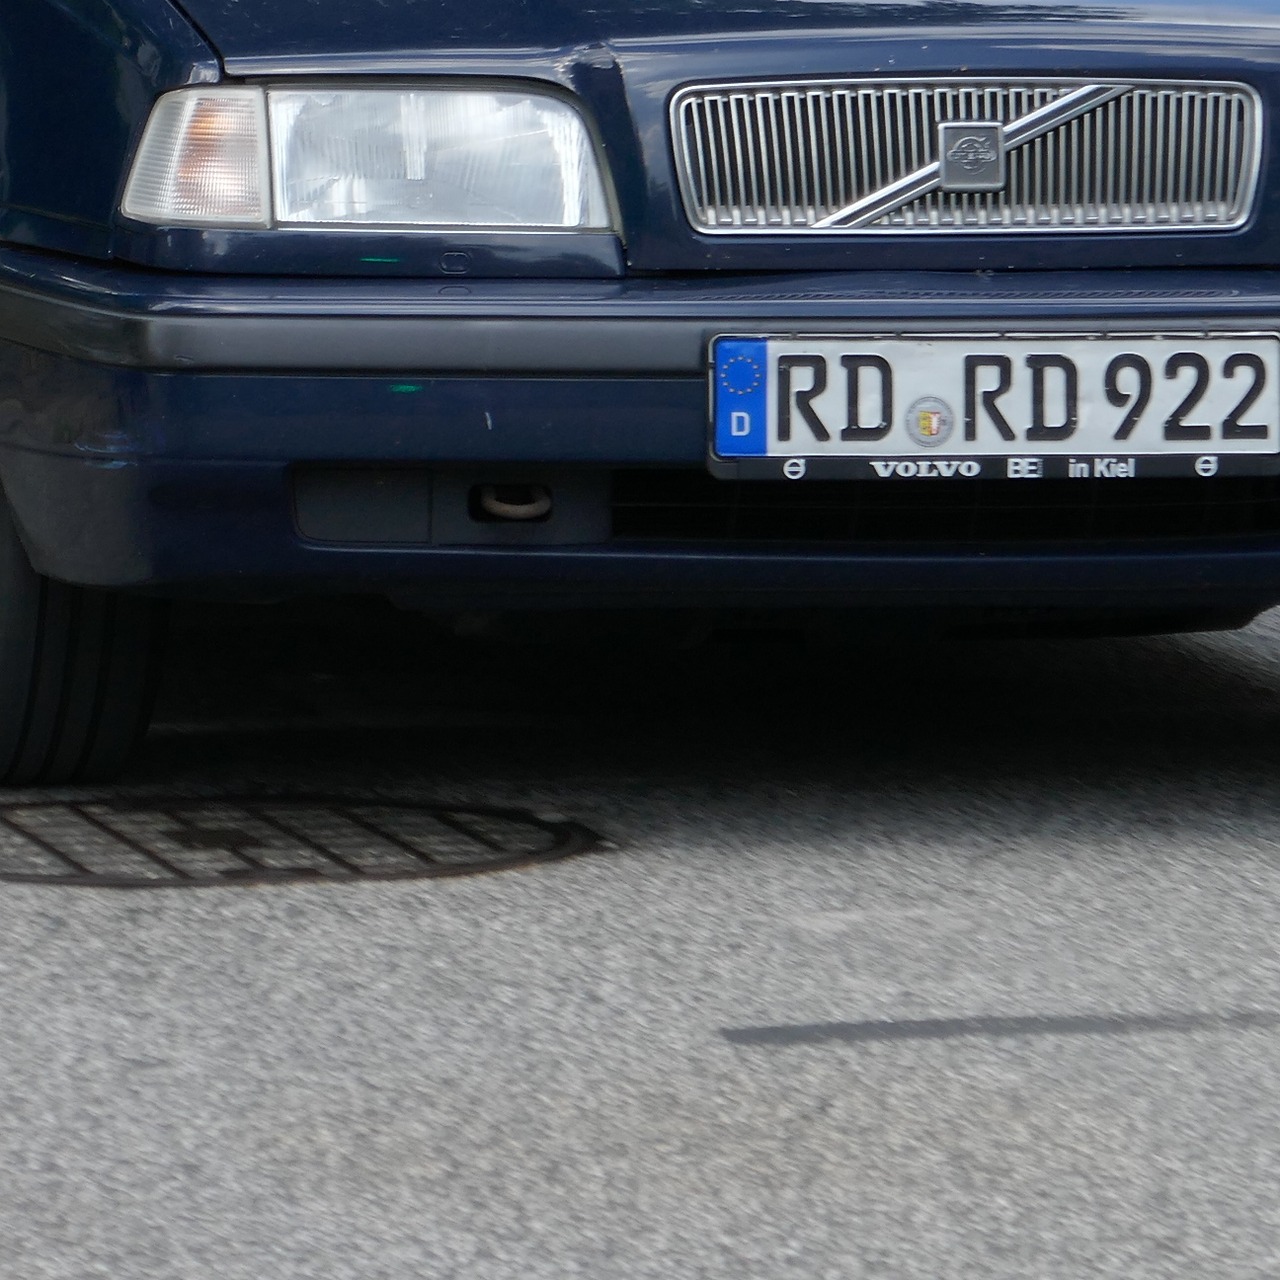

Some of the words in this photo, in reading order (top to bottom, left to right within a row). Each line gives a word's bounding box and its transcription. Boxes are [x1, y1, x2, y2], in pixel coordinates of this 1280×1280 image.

[776, 352, 894, 442] RD
[963, 352, 1079, 442] RD
[1106, 351, 1269, 441] 922
[730, 412, 750, 437] D
[870, 460, 981, 478] VOLVO
[1068, 457, 1090, 478] in
[1093, 457, 1136, 478] Kiel
